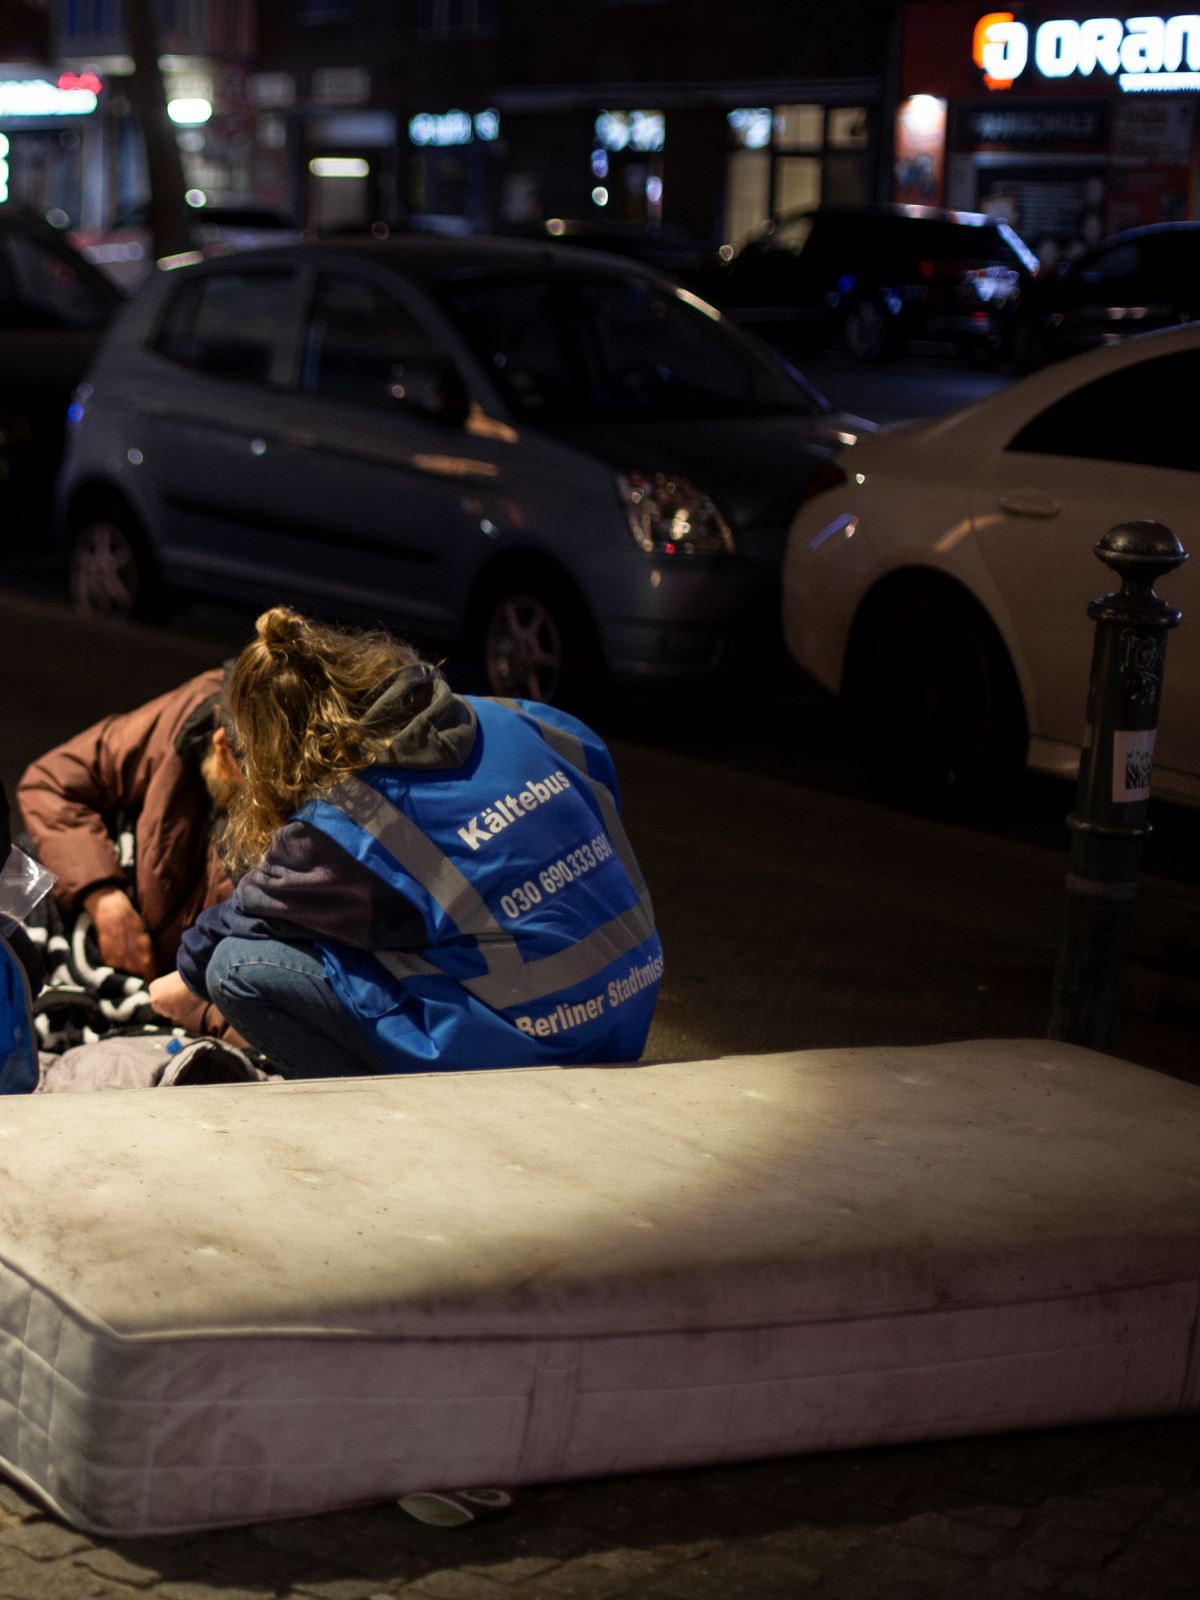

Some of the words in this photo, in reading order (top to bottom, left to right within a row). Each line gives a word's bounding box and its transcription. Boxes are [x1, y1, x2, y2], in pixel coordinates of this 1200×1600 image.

[457, 770, 570, 850] Kältebus
[501, 881, 542, 918] 030
[515, 994, 604, 1036] Berliner
